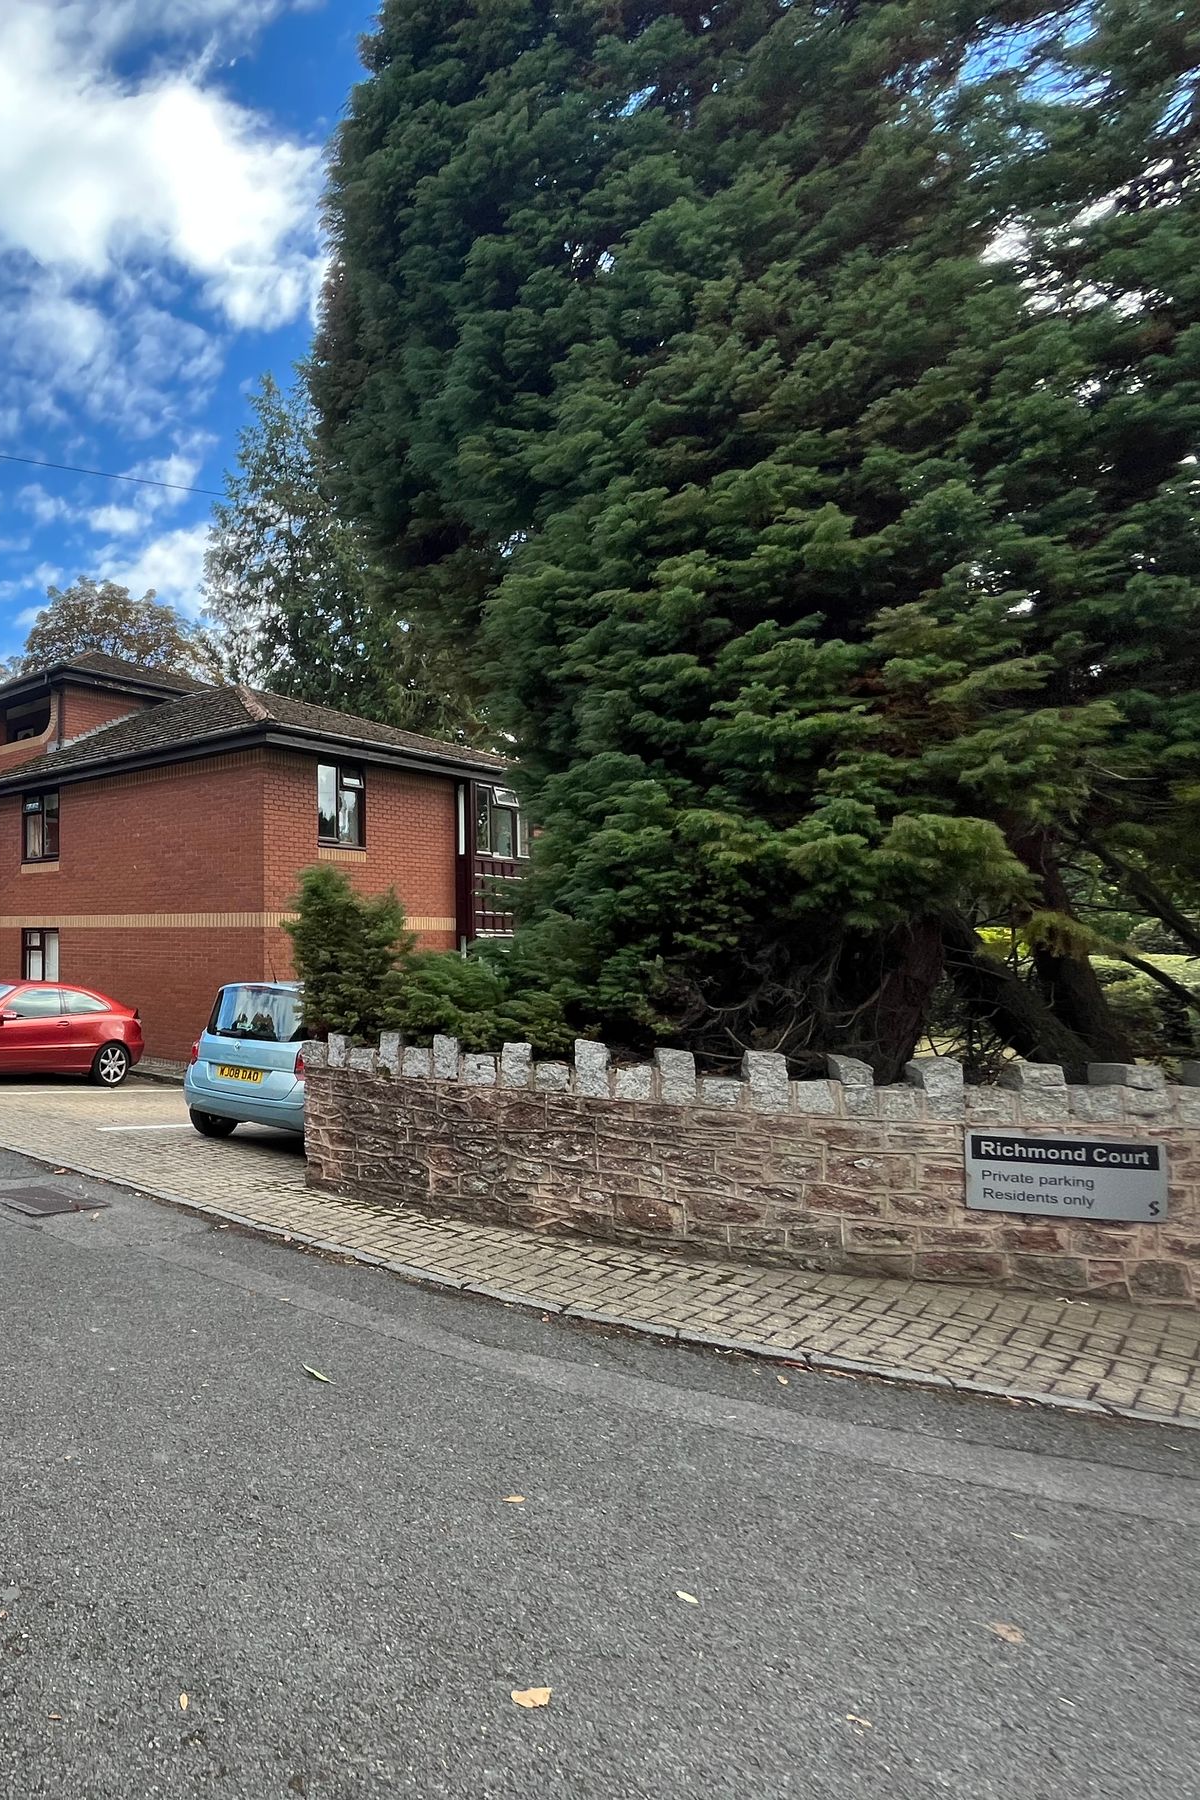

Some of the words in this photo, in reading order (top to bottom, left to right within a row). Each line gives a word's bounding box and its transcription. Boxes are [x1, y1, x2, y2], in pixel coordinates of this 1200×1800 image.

[980, 1141, 1086, 1162] Richmond
[1092, 1148, 1150, 1165] Court
[981, 1169, 1034, 1184] Private
[1039, 1175, 1095, 1191] parking
[983, 1187, 1059, 1204] Residents
[1063, 1195, 1095, 1209] only
